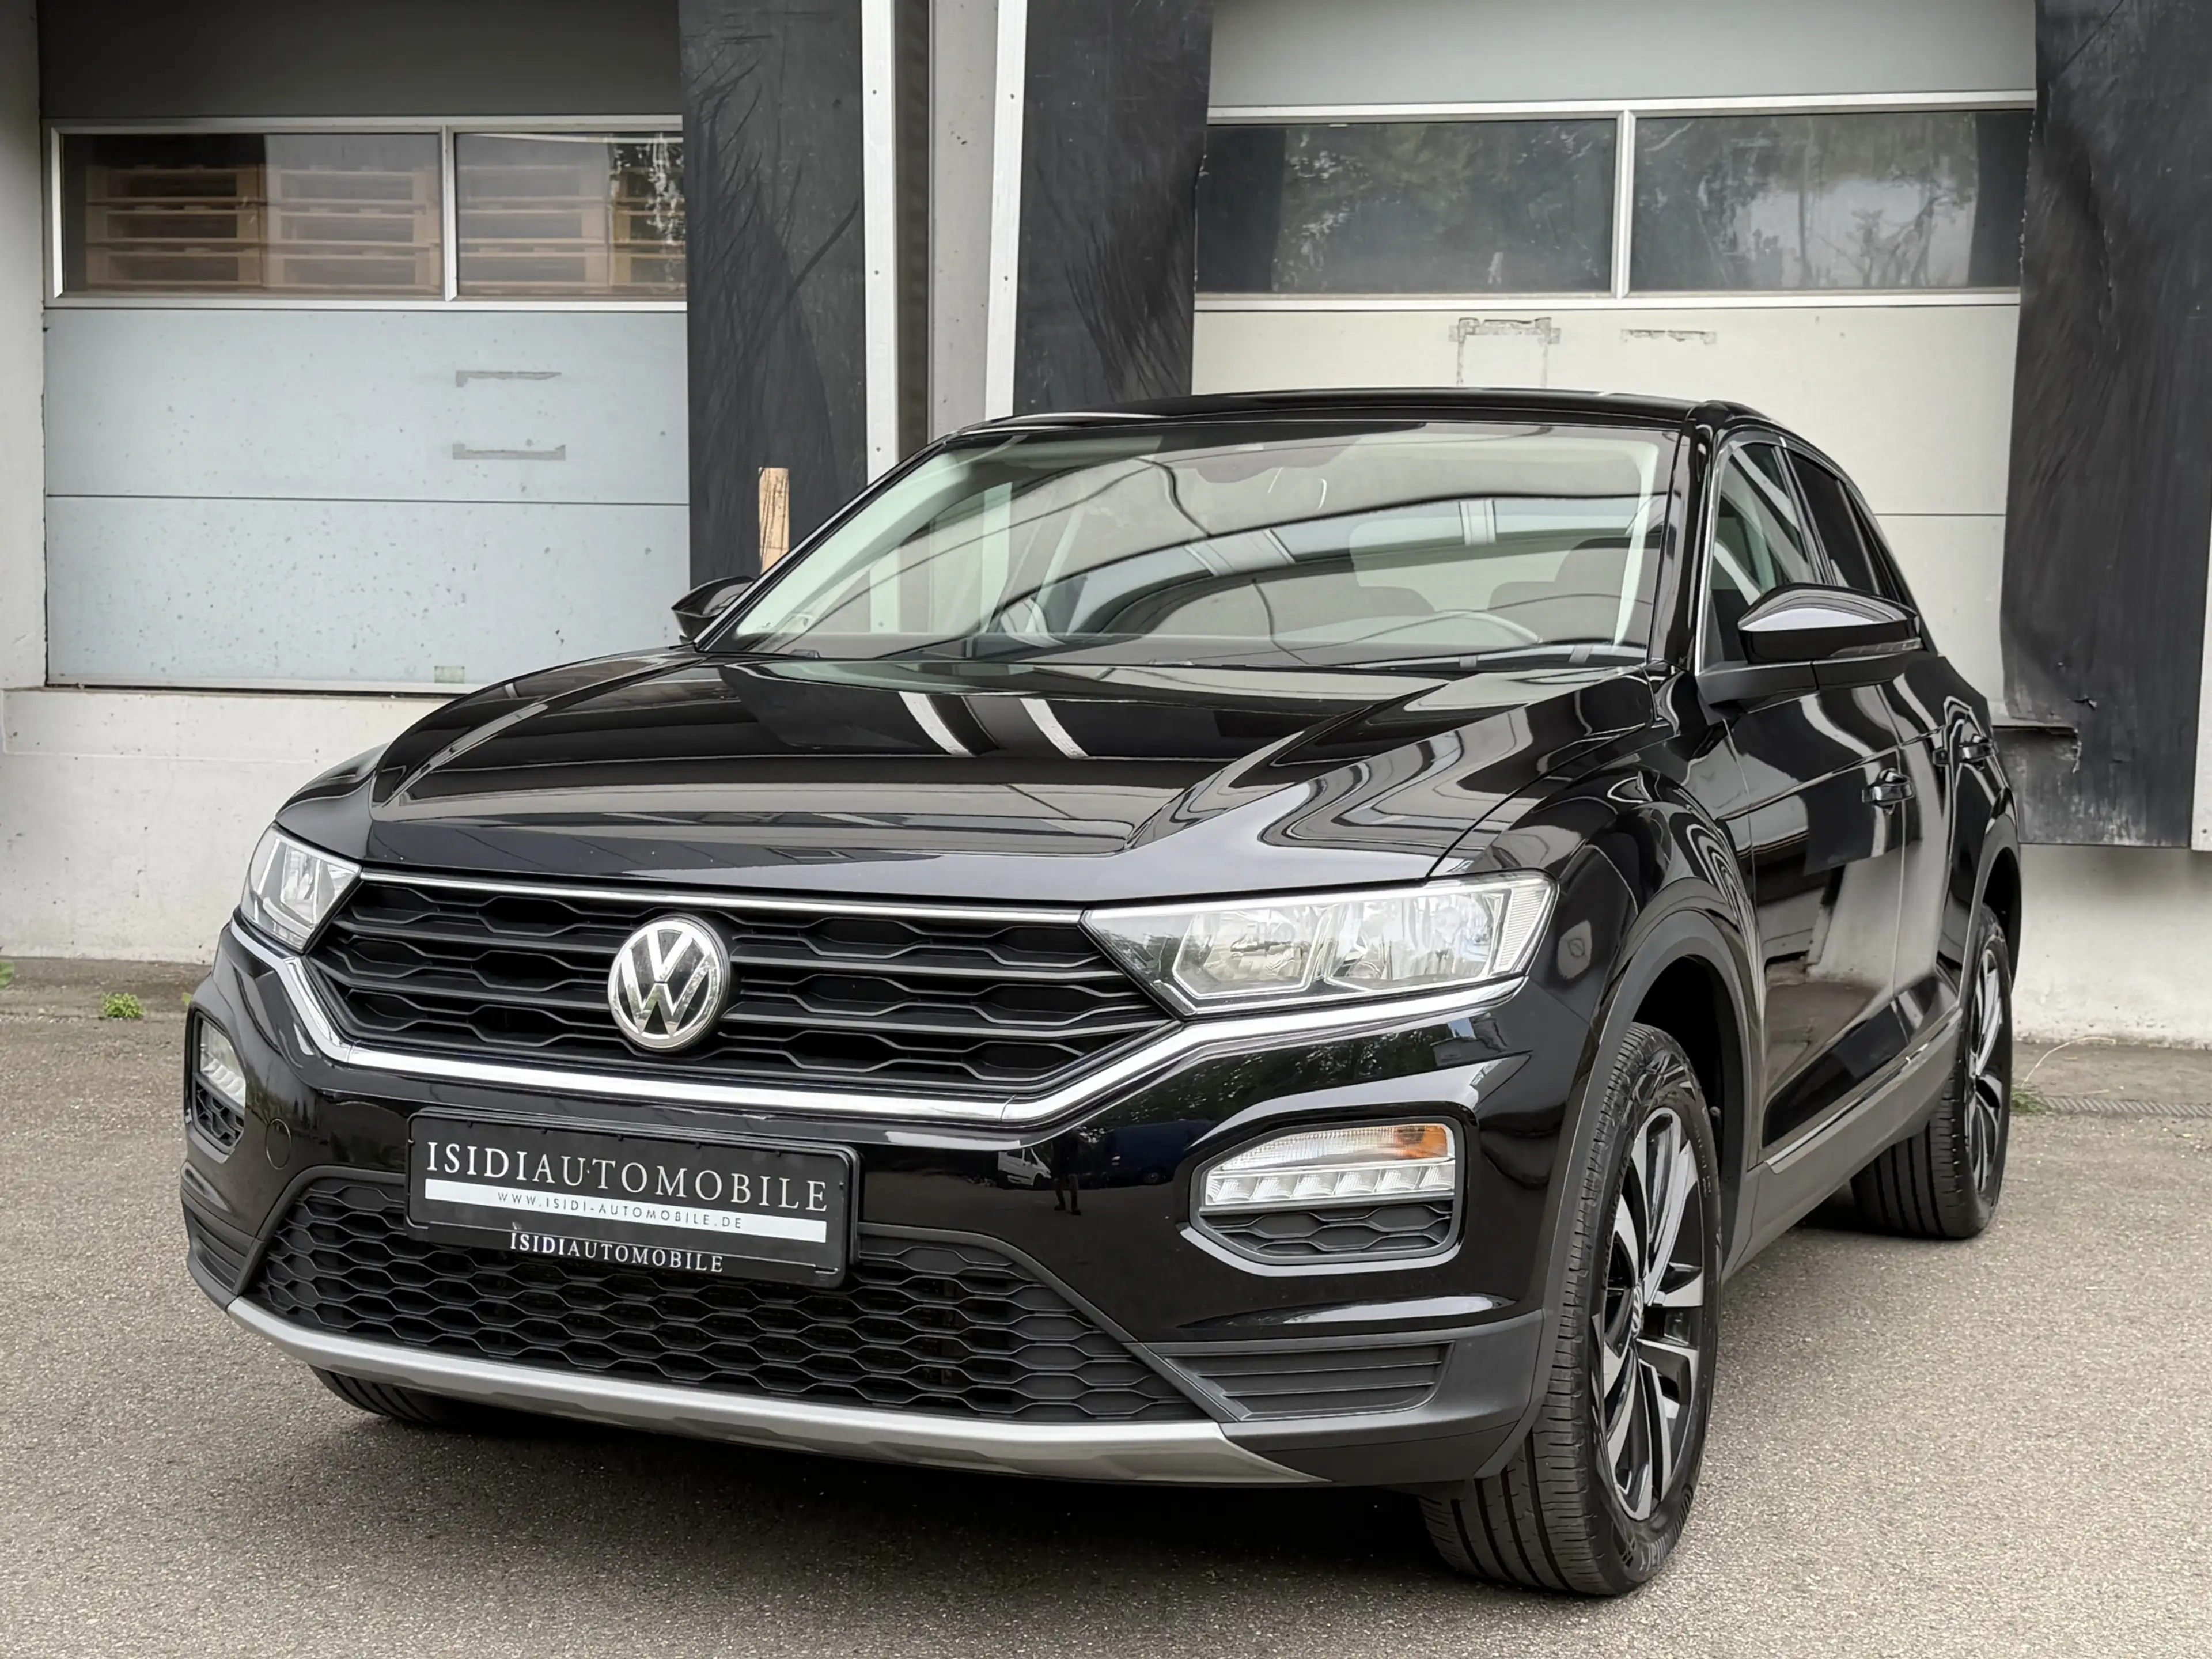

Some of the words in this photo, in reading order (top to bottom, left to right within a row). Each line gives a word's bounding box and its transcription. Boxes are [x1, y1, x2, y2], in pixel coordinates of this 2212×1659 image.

[614, 923, 717, 1041] VW
[426, 1142, 827, 1211] ISIDIAUTOMOBILE
[498, 1192, 741, 1229] WWW.ISIDI-AUTOMOBILE.DE
[510, 1233, 723, 1272] ISIDIAUTOMOBILE
